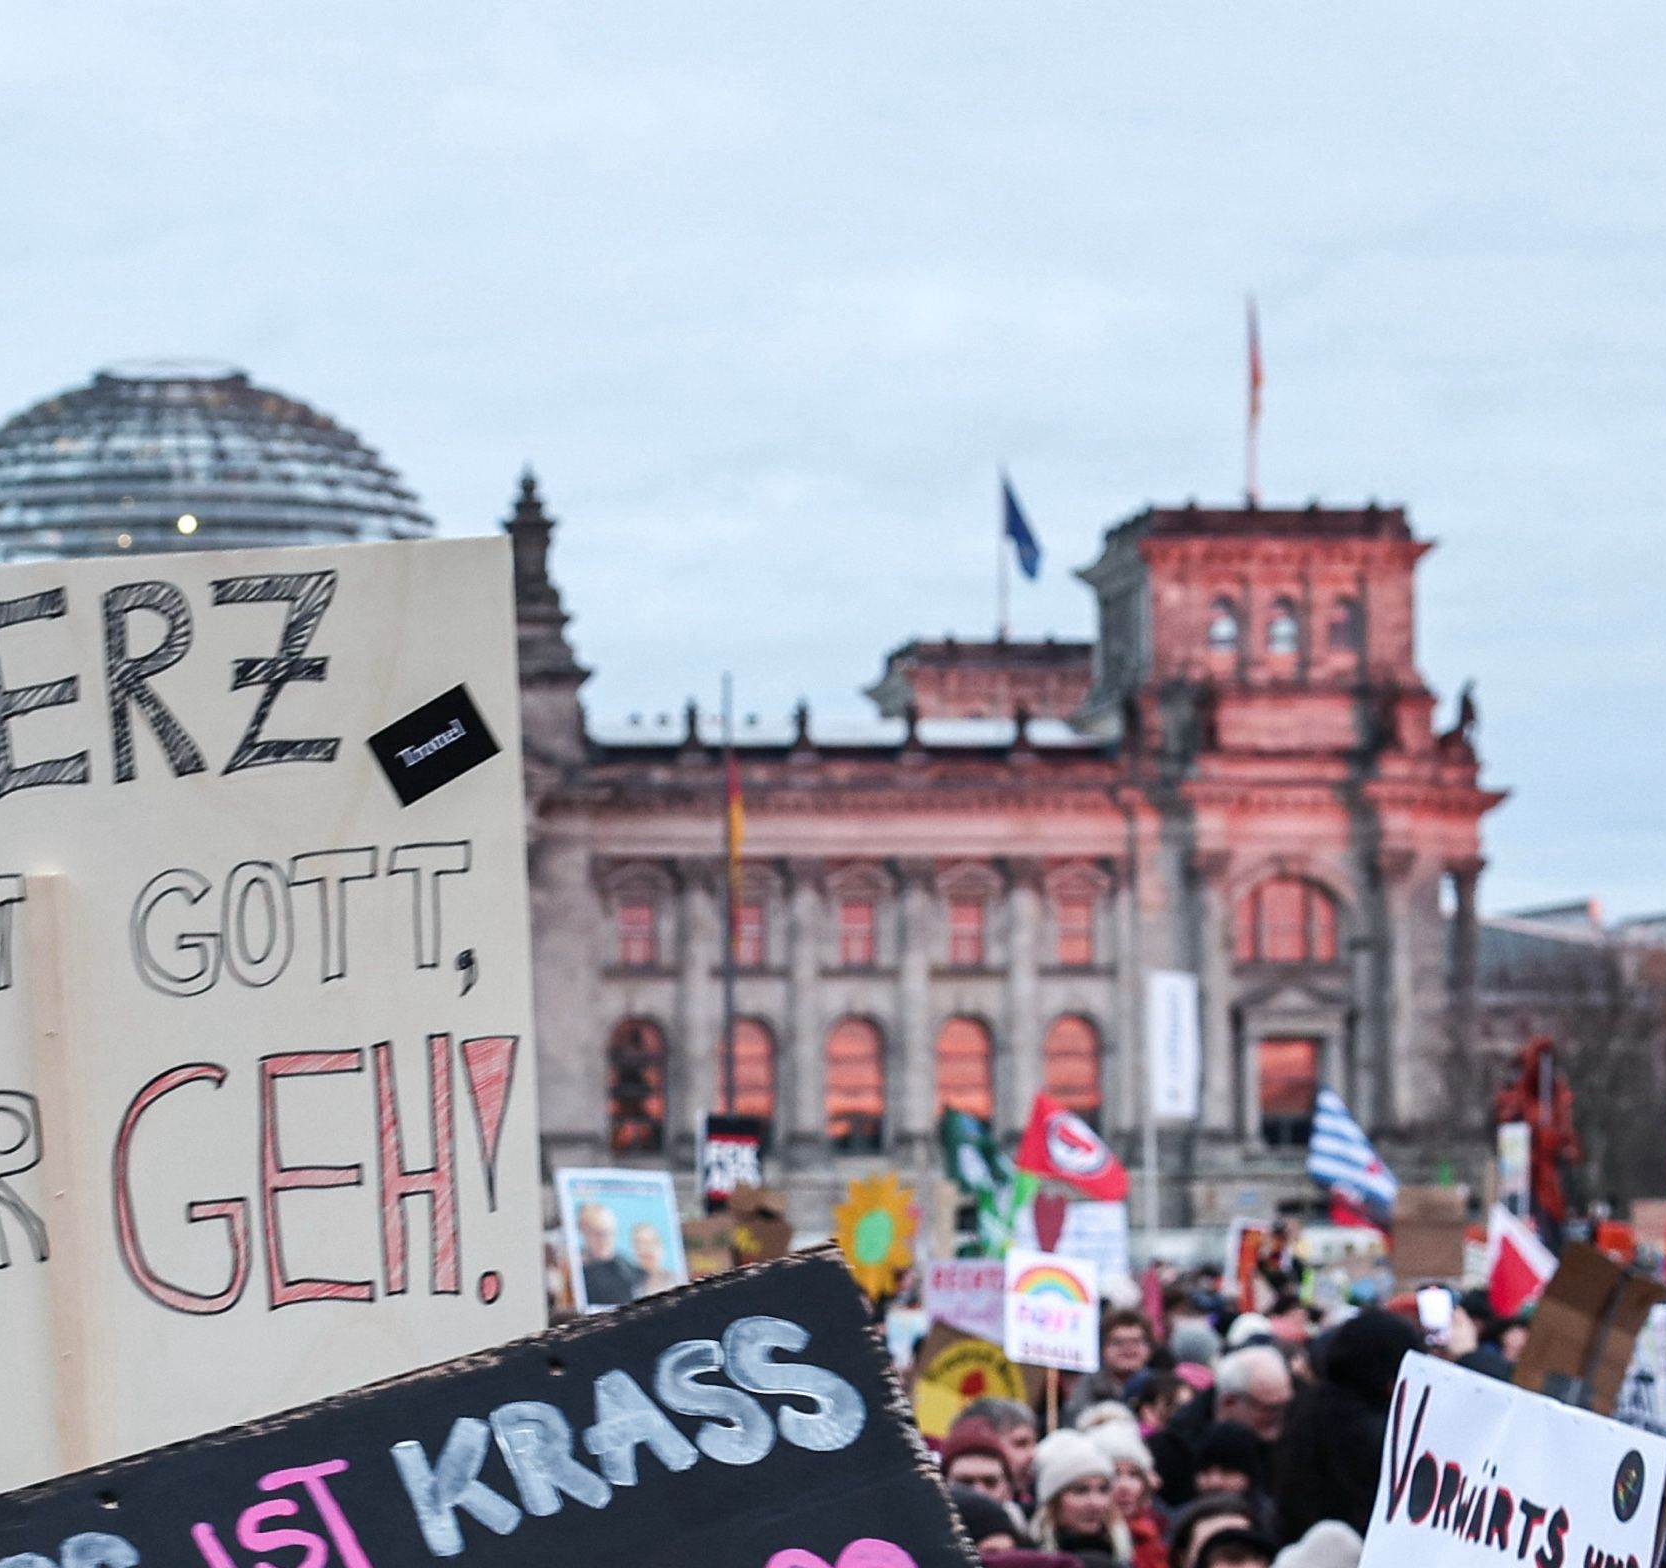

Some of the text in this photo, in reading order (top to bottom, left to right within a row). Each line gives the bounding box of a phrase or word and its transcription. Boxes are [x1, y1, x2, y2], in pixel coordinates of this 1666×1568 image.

[134, 840, 478, 998] GOTT,
[112, 1032, 521, 1316] GEH!
[390, 1315, 866, 1556] KRASS
